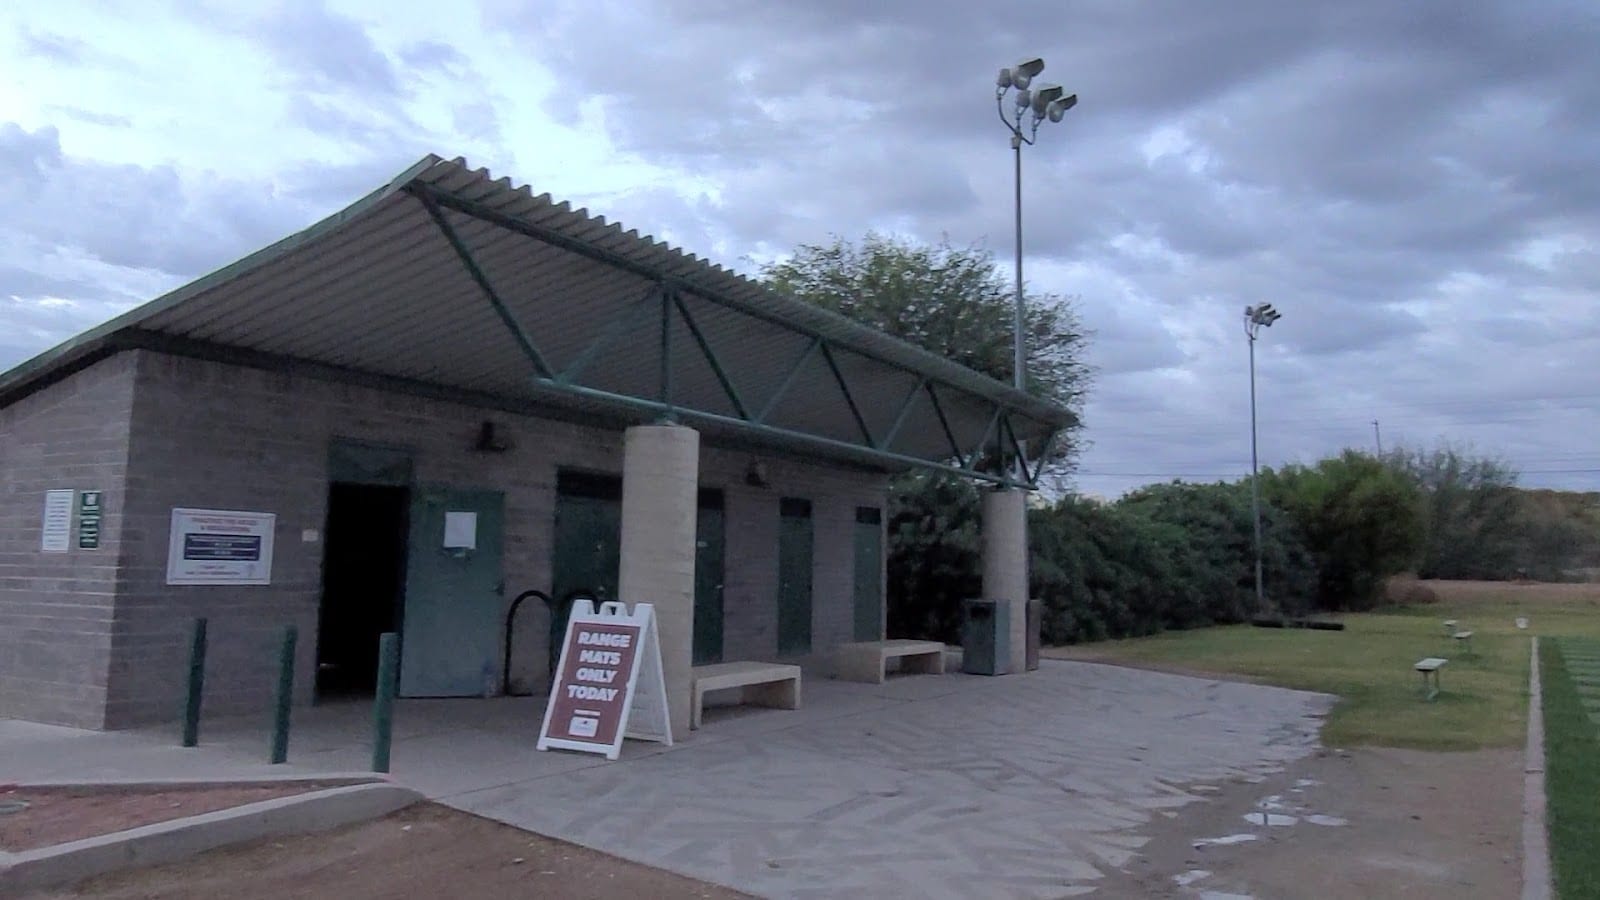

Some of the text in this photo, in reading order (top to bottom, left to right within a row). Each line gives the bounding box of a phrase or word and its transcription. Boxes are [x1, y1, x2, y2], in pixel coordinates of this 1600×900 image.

[578, 631, 631, 648] RANGE
[579, 649, 621, 665] MATS
[576, 667, 618, 683] ONLY
[567, 684, 619, 701] TODAY
